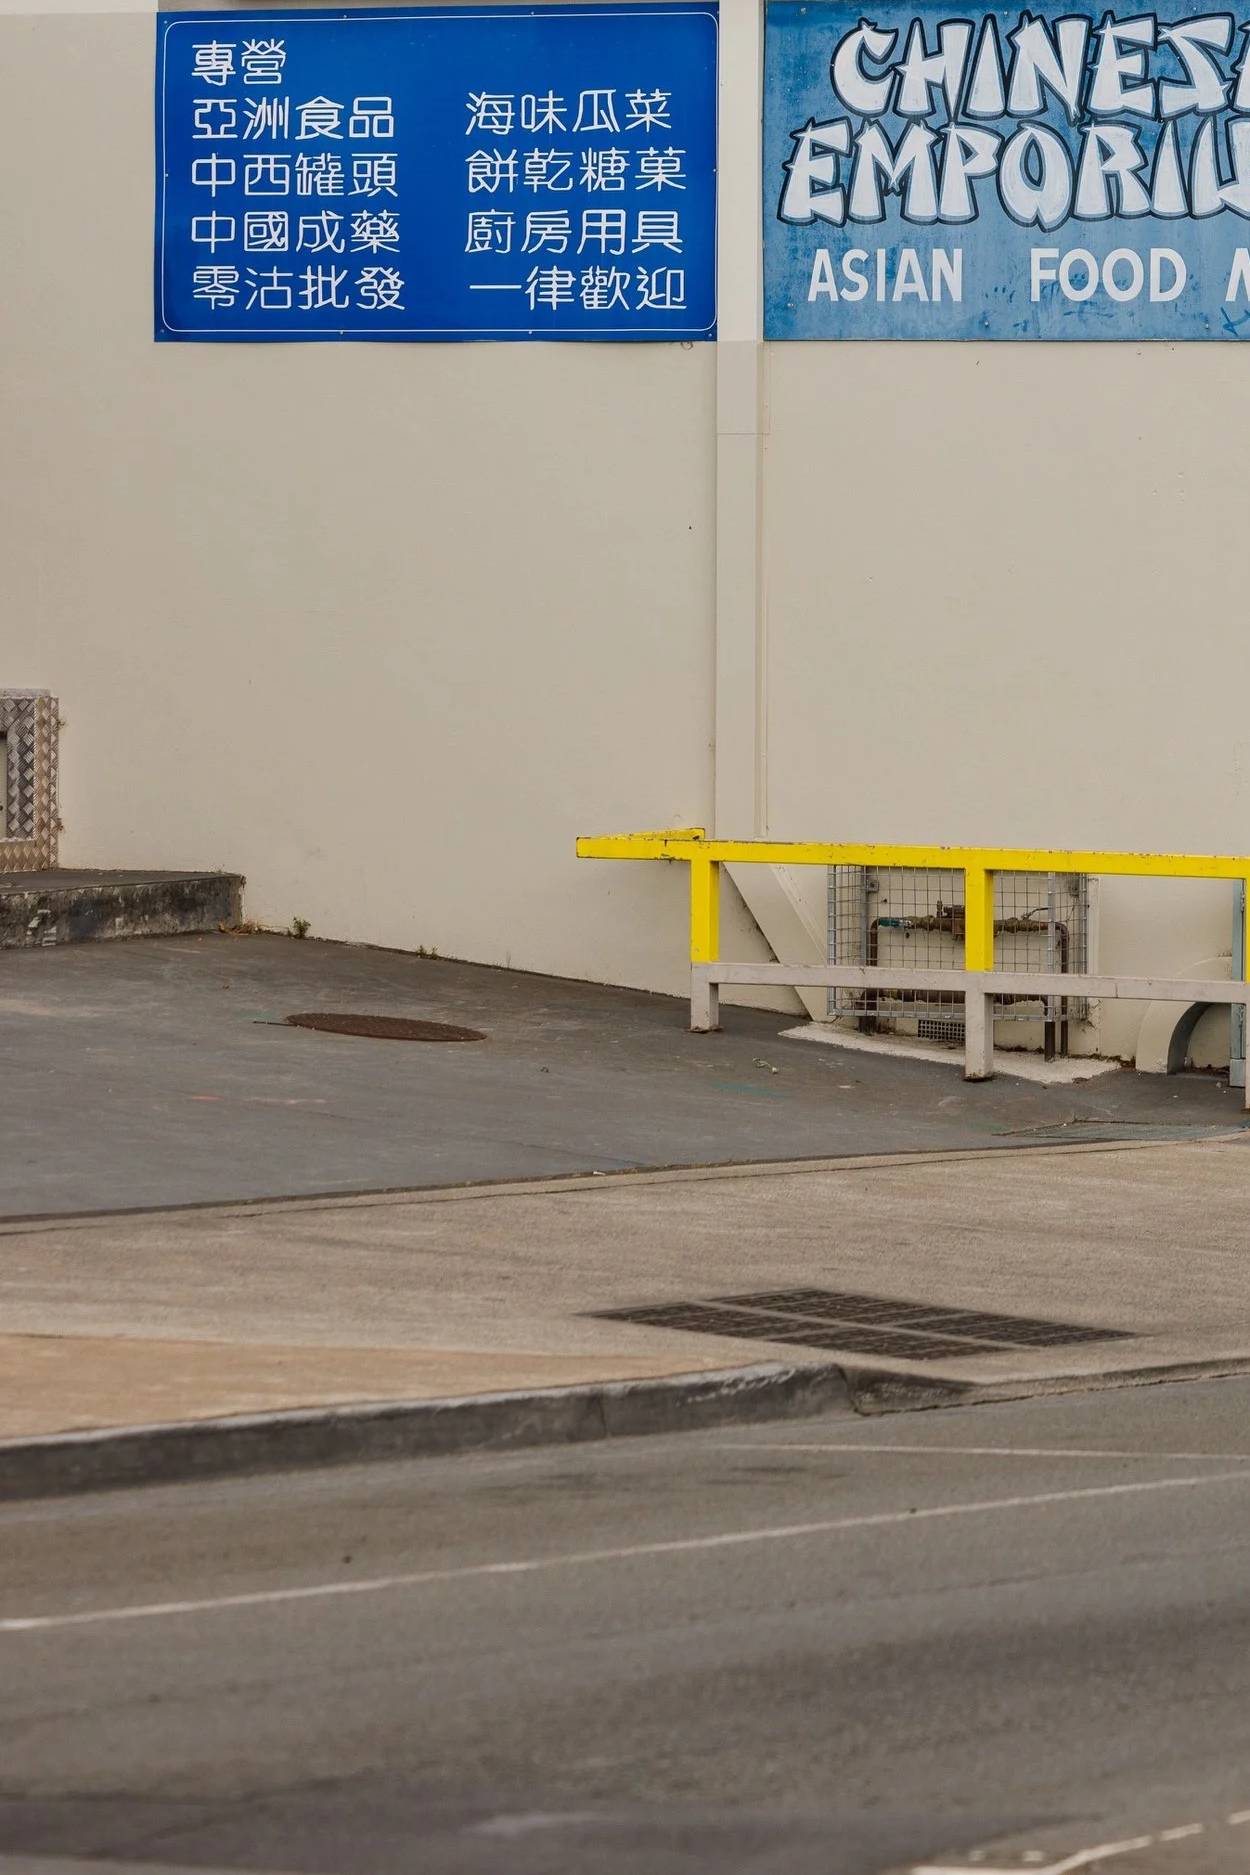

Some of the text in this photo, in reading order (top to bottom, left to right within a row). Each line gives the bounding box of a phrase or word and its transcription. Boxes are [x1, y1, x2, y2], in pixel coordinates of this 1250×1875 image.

[191, 38, 288, 86] 專營
[191, 94, 395, 141] 亞洲食品
[464, 88, 673, 136] 海味瓜菜
[191, 152, 399, 198] 中西罐頭
[464, 146, 688, 194] 餅乾糖菓
[191, 209, 401, 255] 中國成藥
[191, 264, 405, 312] 零沽批發
[469, 264, 688, 311] 一律歡迎
[807, 247, 963, 302] ASIAN
[1030, 247, 1188, 303] FOOD
